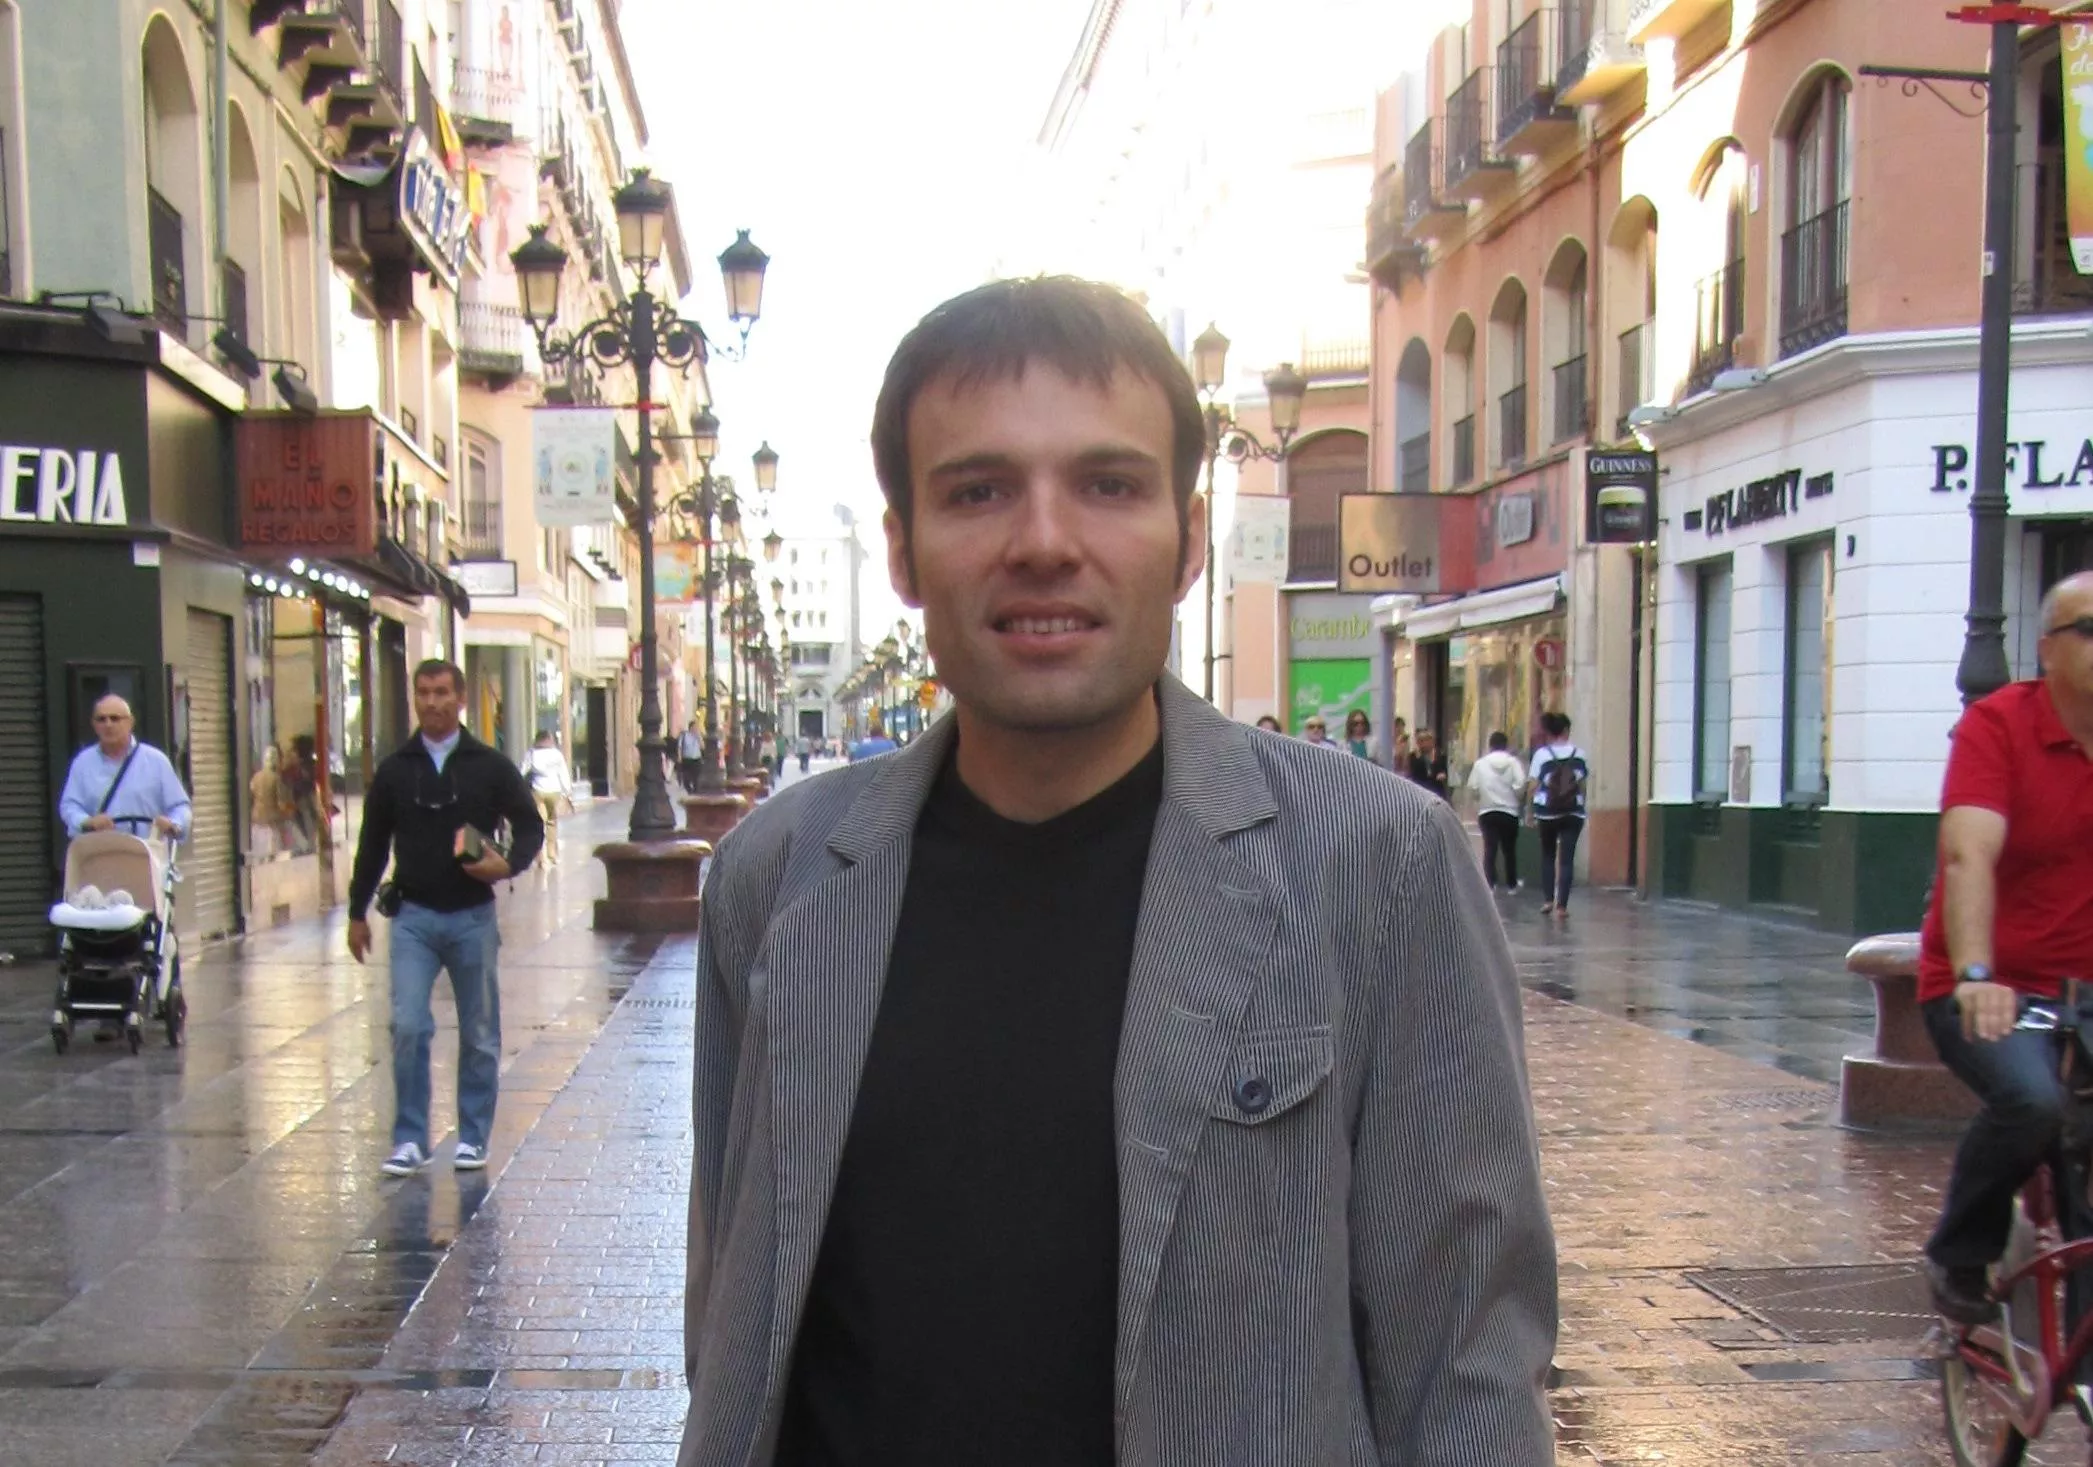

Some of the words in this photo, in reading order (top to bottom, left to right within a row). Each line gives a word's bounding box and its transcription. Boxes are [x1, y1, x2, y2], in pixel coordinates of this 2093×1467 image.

[1590, 456, 1653, 474] GUINNESS
[0, 445, 128, 526] ERIA
[242, 519, 357, 545] REGALOS
[1348, 552, 1433, 578] Outlet
